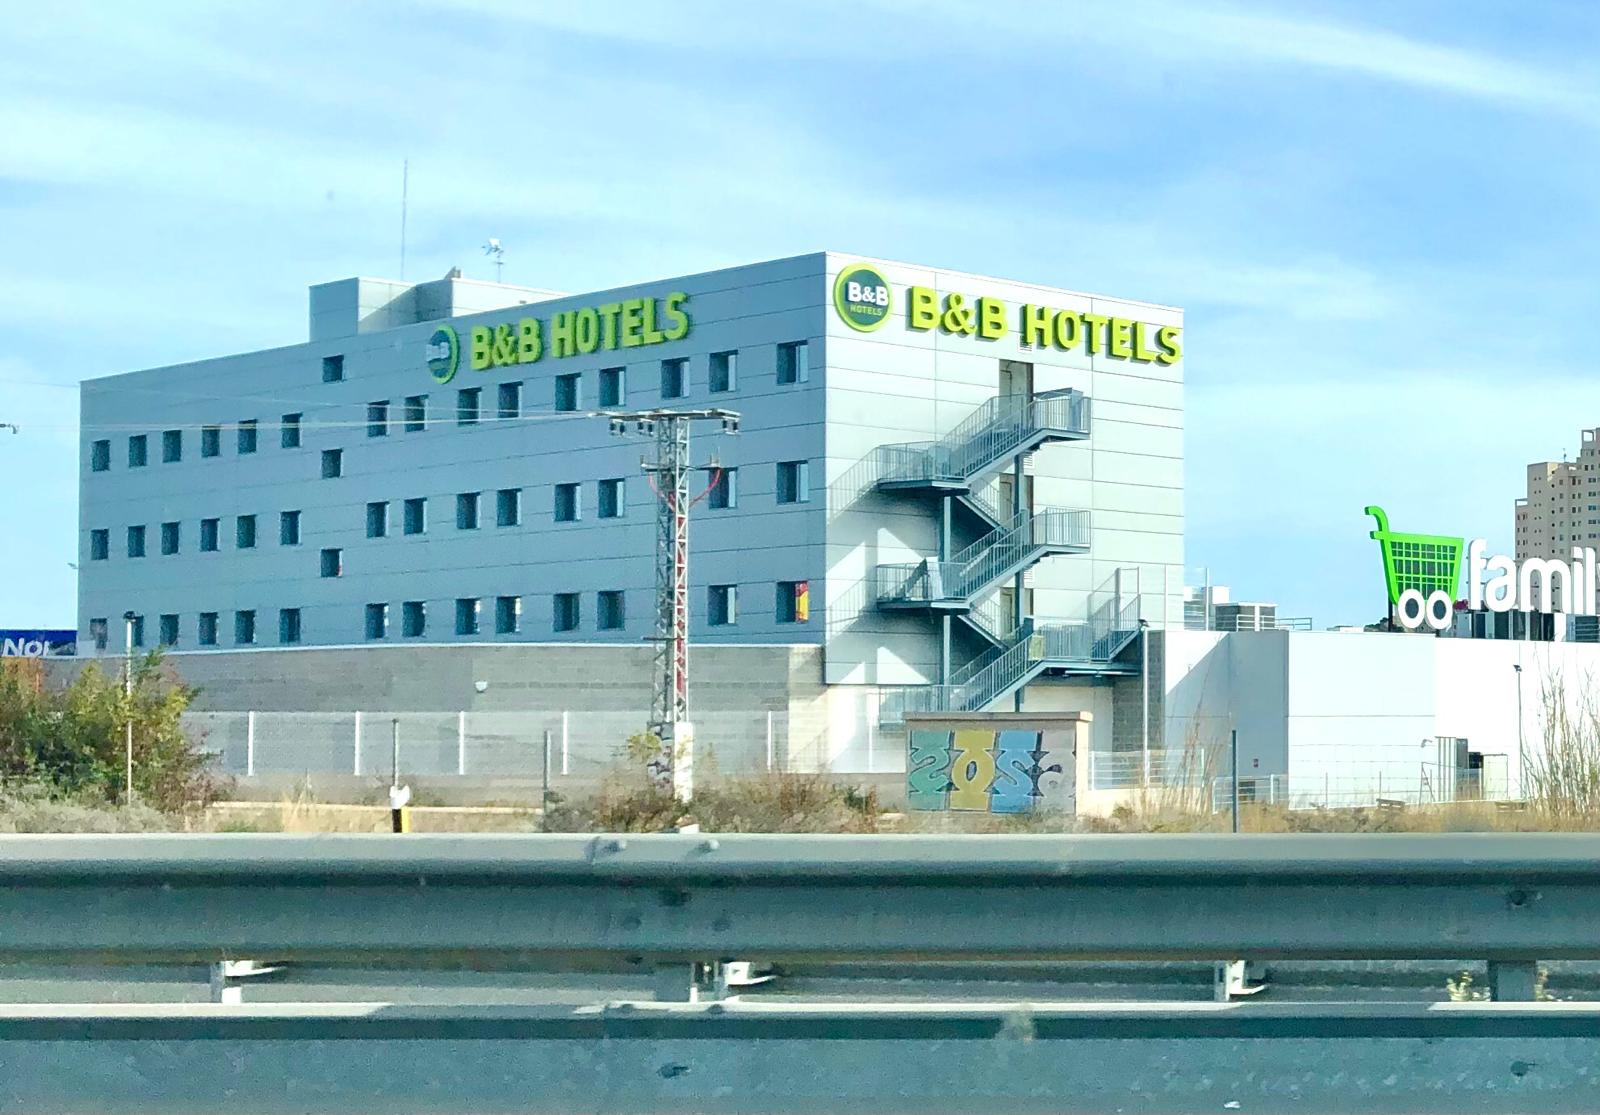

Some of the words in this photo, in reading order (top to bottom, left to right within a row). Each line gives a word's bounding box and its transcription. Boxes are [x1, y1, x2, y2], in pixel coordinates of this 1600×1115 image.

[470, 317, 541, 371] B&B
[551, 291, 690, 358] HOTELS
[848, 281, 889, 306] B&B
[849, 303, 883, 316] HOTELS
[908, 285, 1008, 342] B&B
[1021, 303, 1184, 366] HOTELS
[1467, 538, 1600, 616] famil
